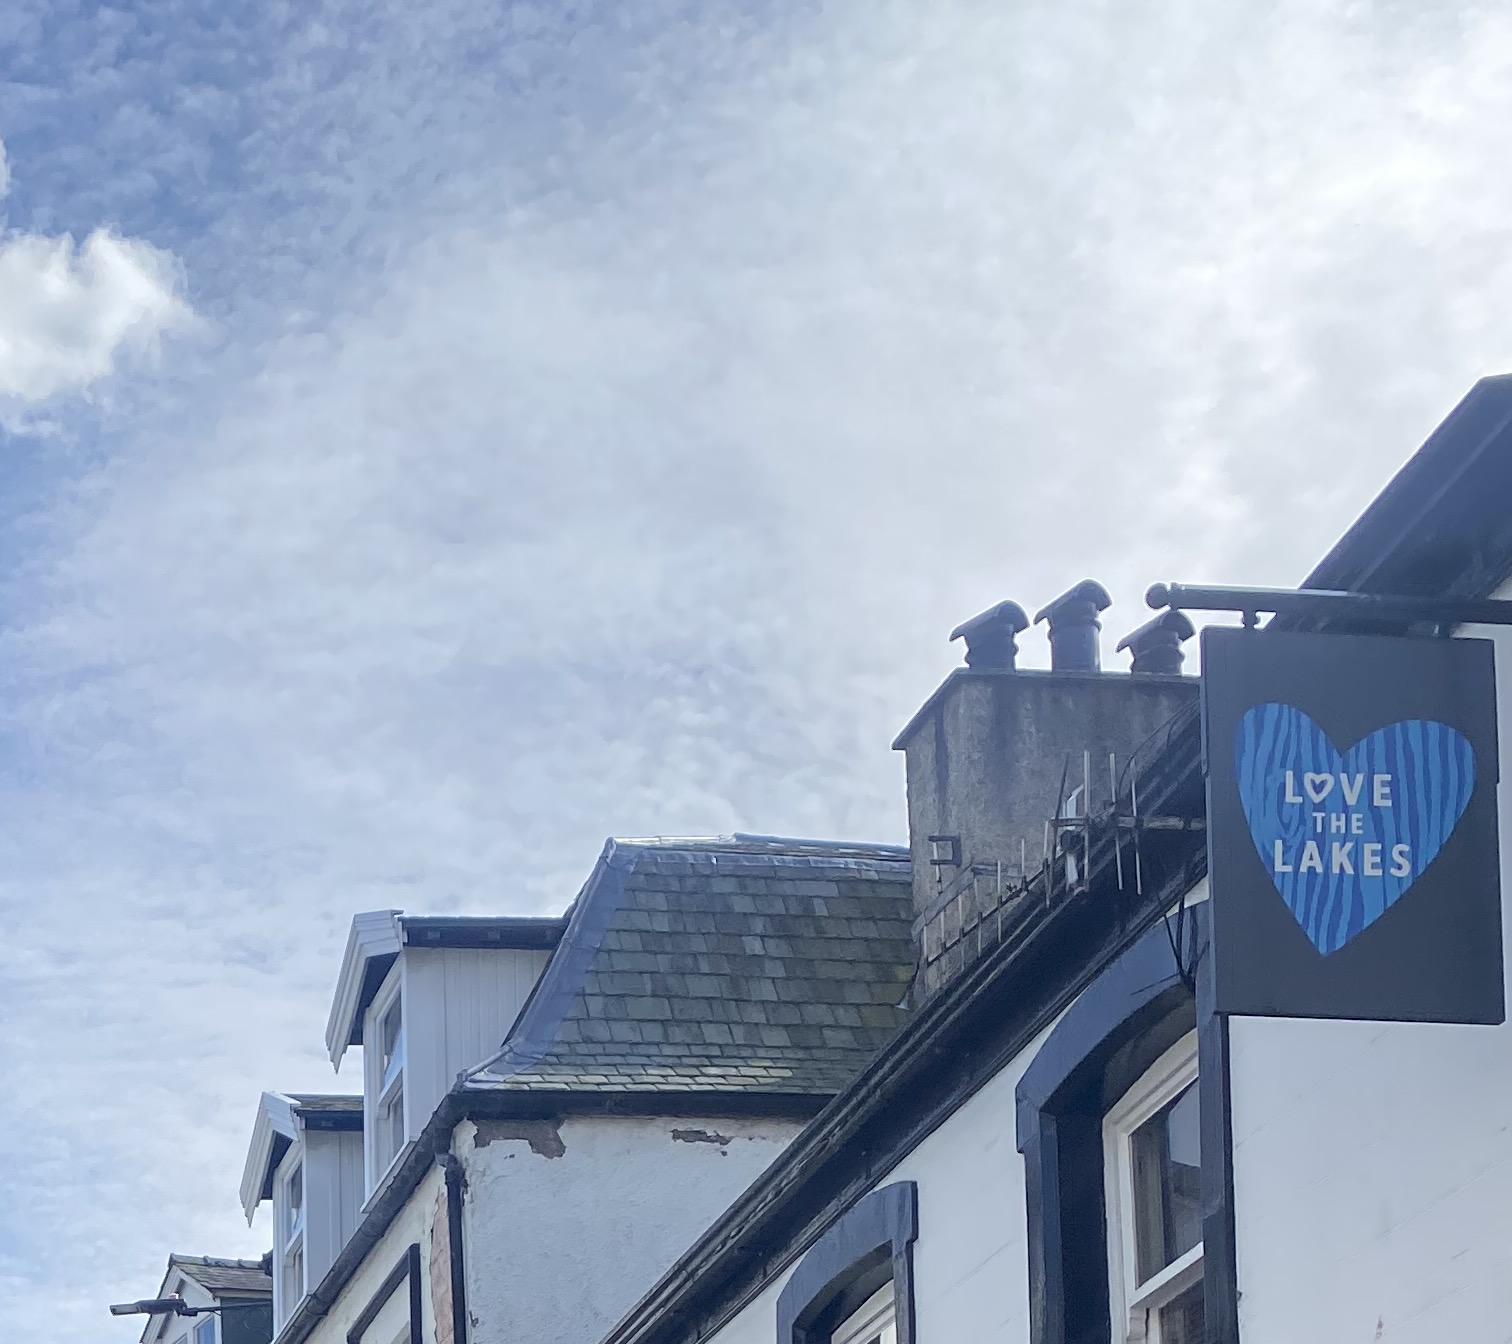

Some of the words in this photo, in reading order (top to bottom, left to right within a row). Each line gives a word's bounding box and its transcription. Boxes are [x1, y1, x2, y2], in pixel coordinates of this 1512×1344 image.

[1285, 770, 1392, 807] LOVE
[1312, 812, 1364, 834] THE
[1274, 839, 1412, 878] LAKES
